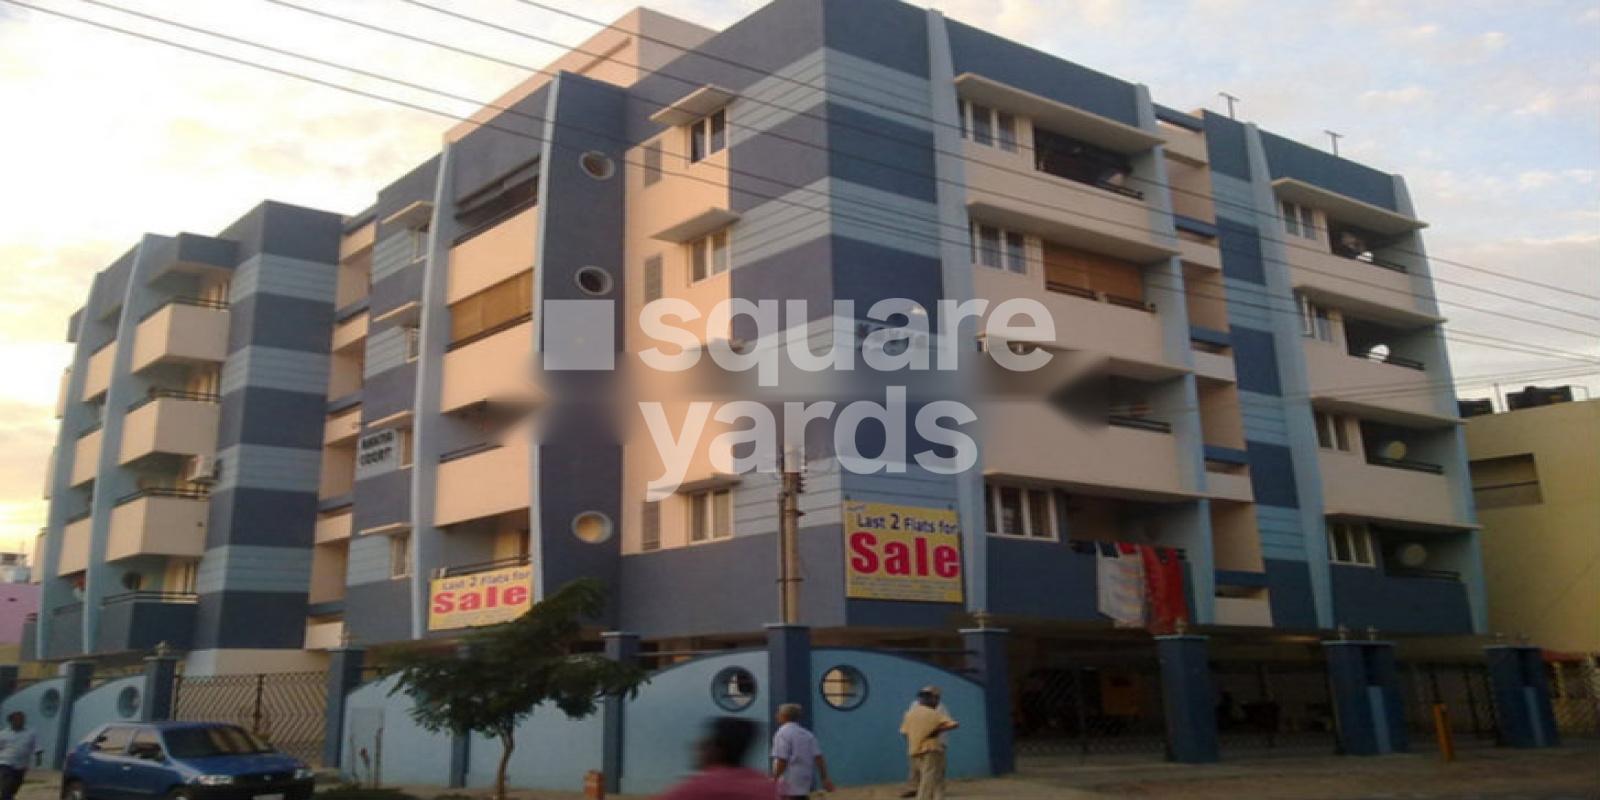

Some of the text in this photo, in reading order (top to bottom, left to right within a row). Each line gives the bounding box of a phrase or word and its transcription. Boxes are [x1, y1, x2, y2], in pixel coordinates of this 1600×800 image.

[858, 513, 885, 528] Last
[889, 513, 899, 529] 2
[905, 517, 935, 533] Flats
[850, 531, 959, 577] Sale
[432, 585, 529, 614] Sale
